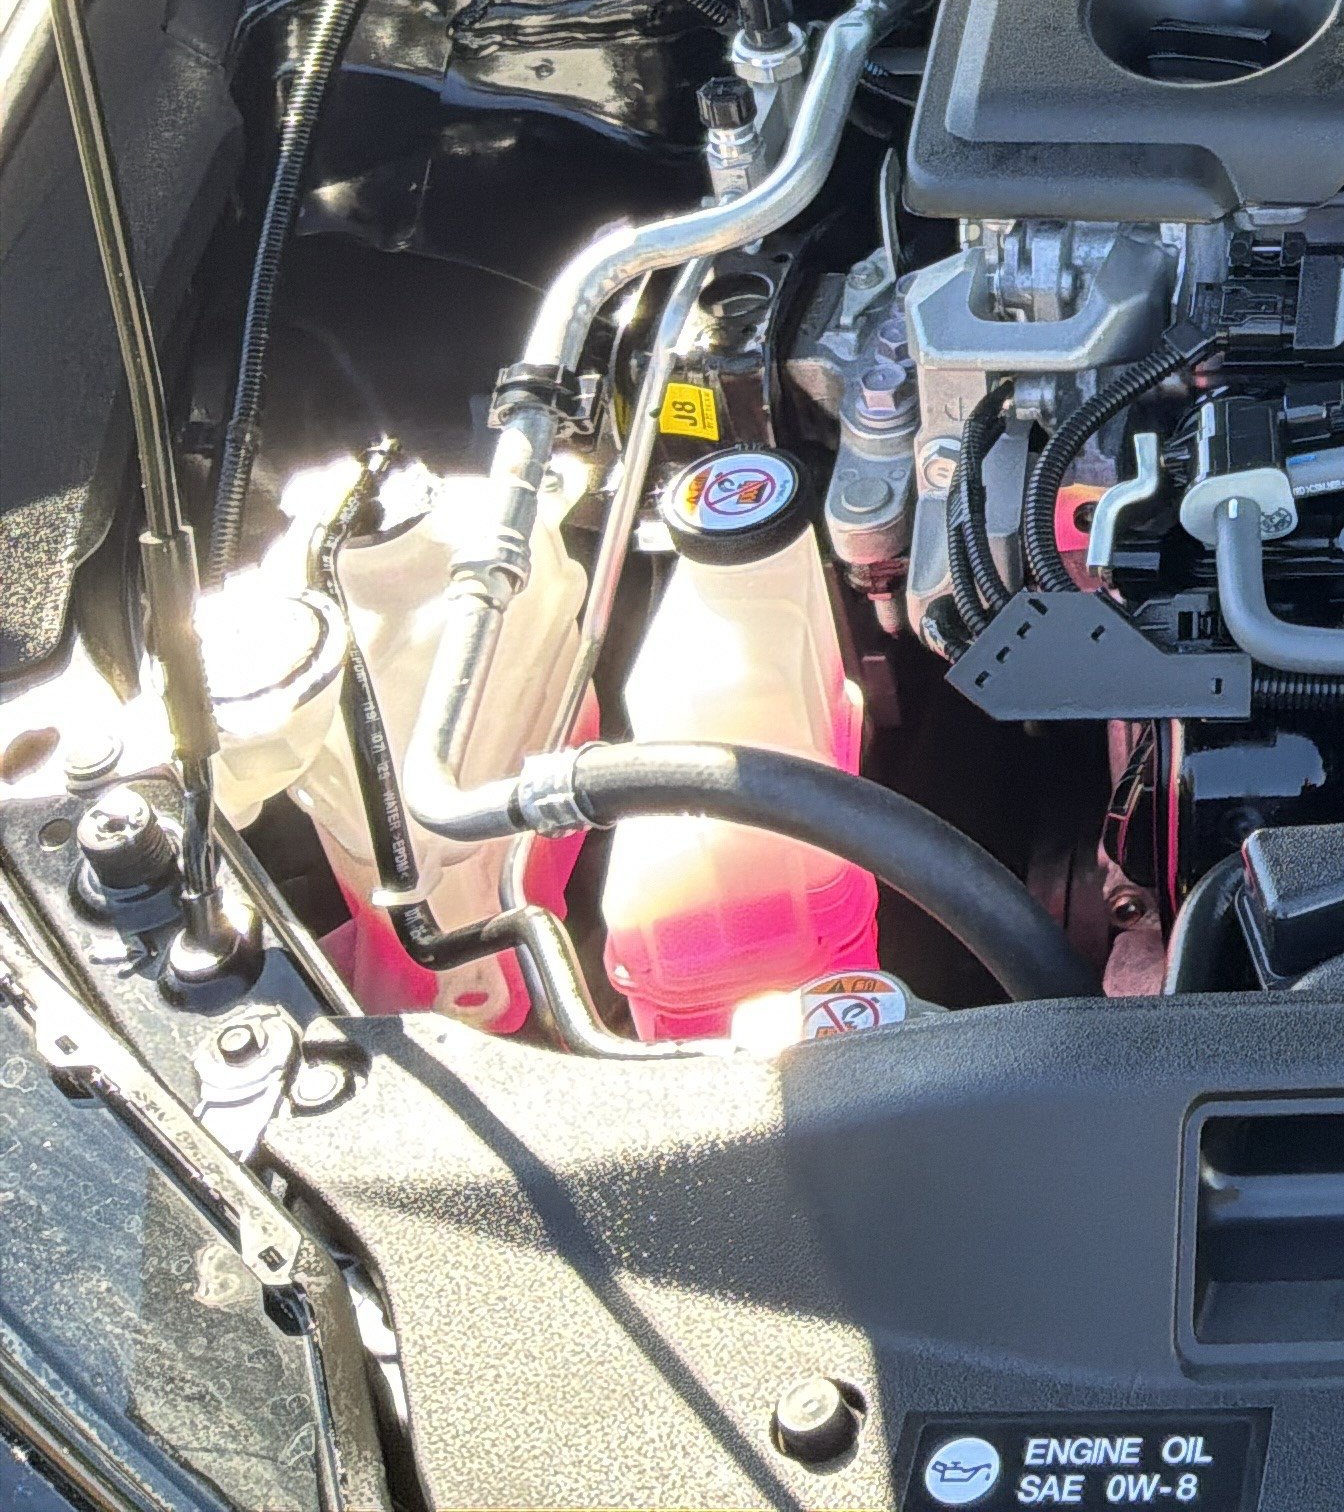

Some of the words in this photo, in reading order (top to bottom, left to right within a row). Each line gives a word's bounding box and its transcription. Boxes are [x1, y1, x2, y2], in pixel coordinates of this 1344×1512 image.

[671, 400, 698, 427] J8
[1024, 1437, 1143, 1465] ENGINE
[1162, 1436, 1213, 1465] OIL
[1017, 1474, 1085, 1502] SAE
[1106, 1473, 1198, 1503] 0W-8
